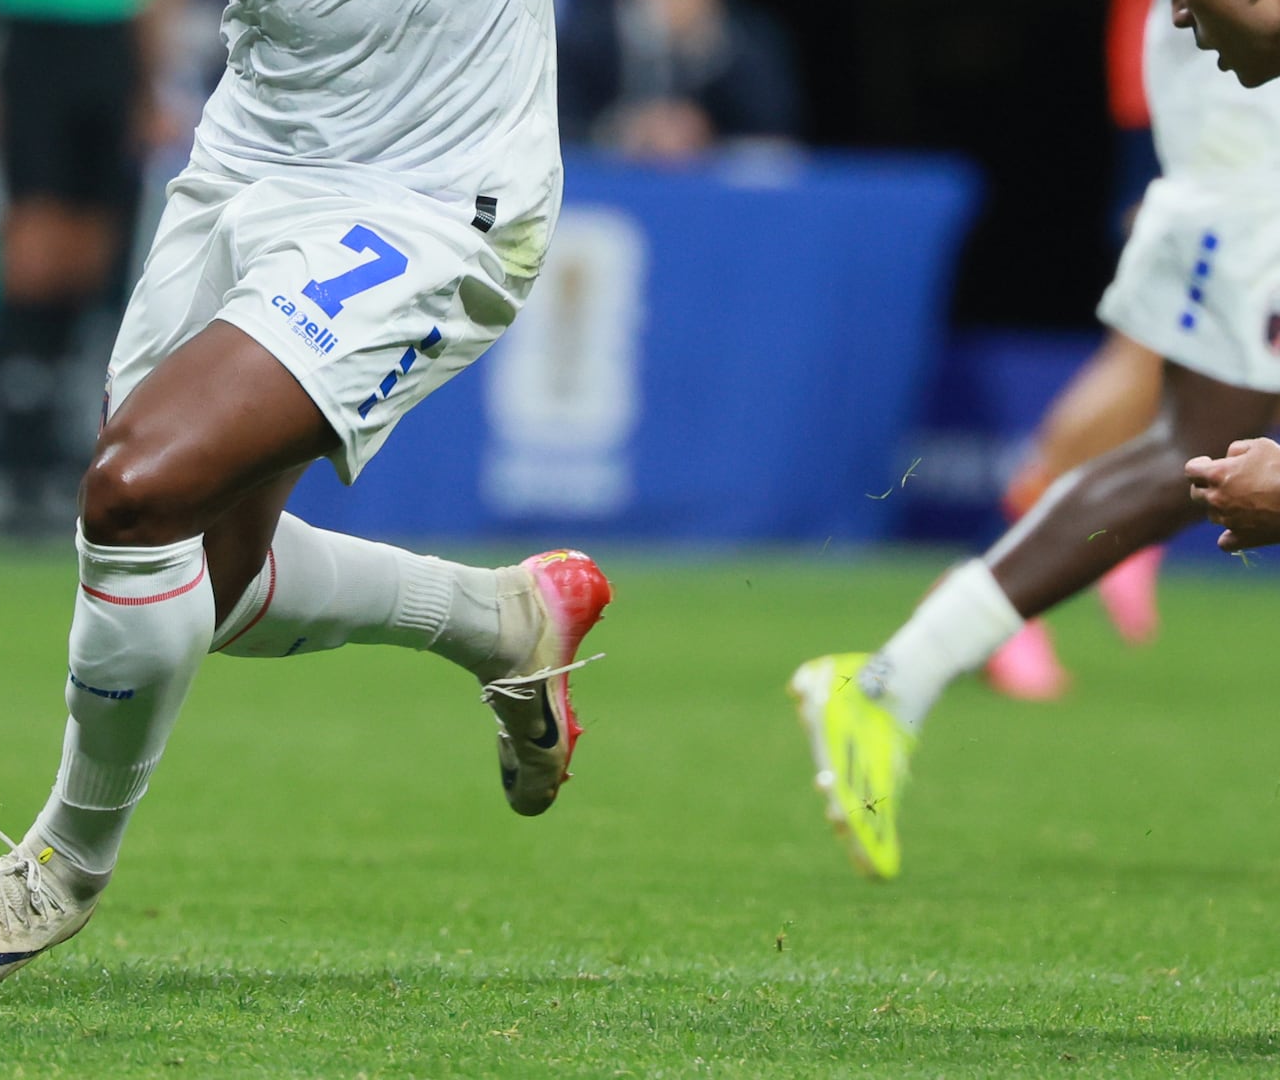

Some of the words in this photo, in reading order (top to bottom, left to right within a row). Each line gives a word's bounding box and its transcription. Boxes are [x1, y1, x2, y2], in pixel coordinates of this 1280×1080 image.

[301, 224, 409, 320] 7
[271, 295, 338, 353] capelli
[290, 325, 327, 357] SPORT
